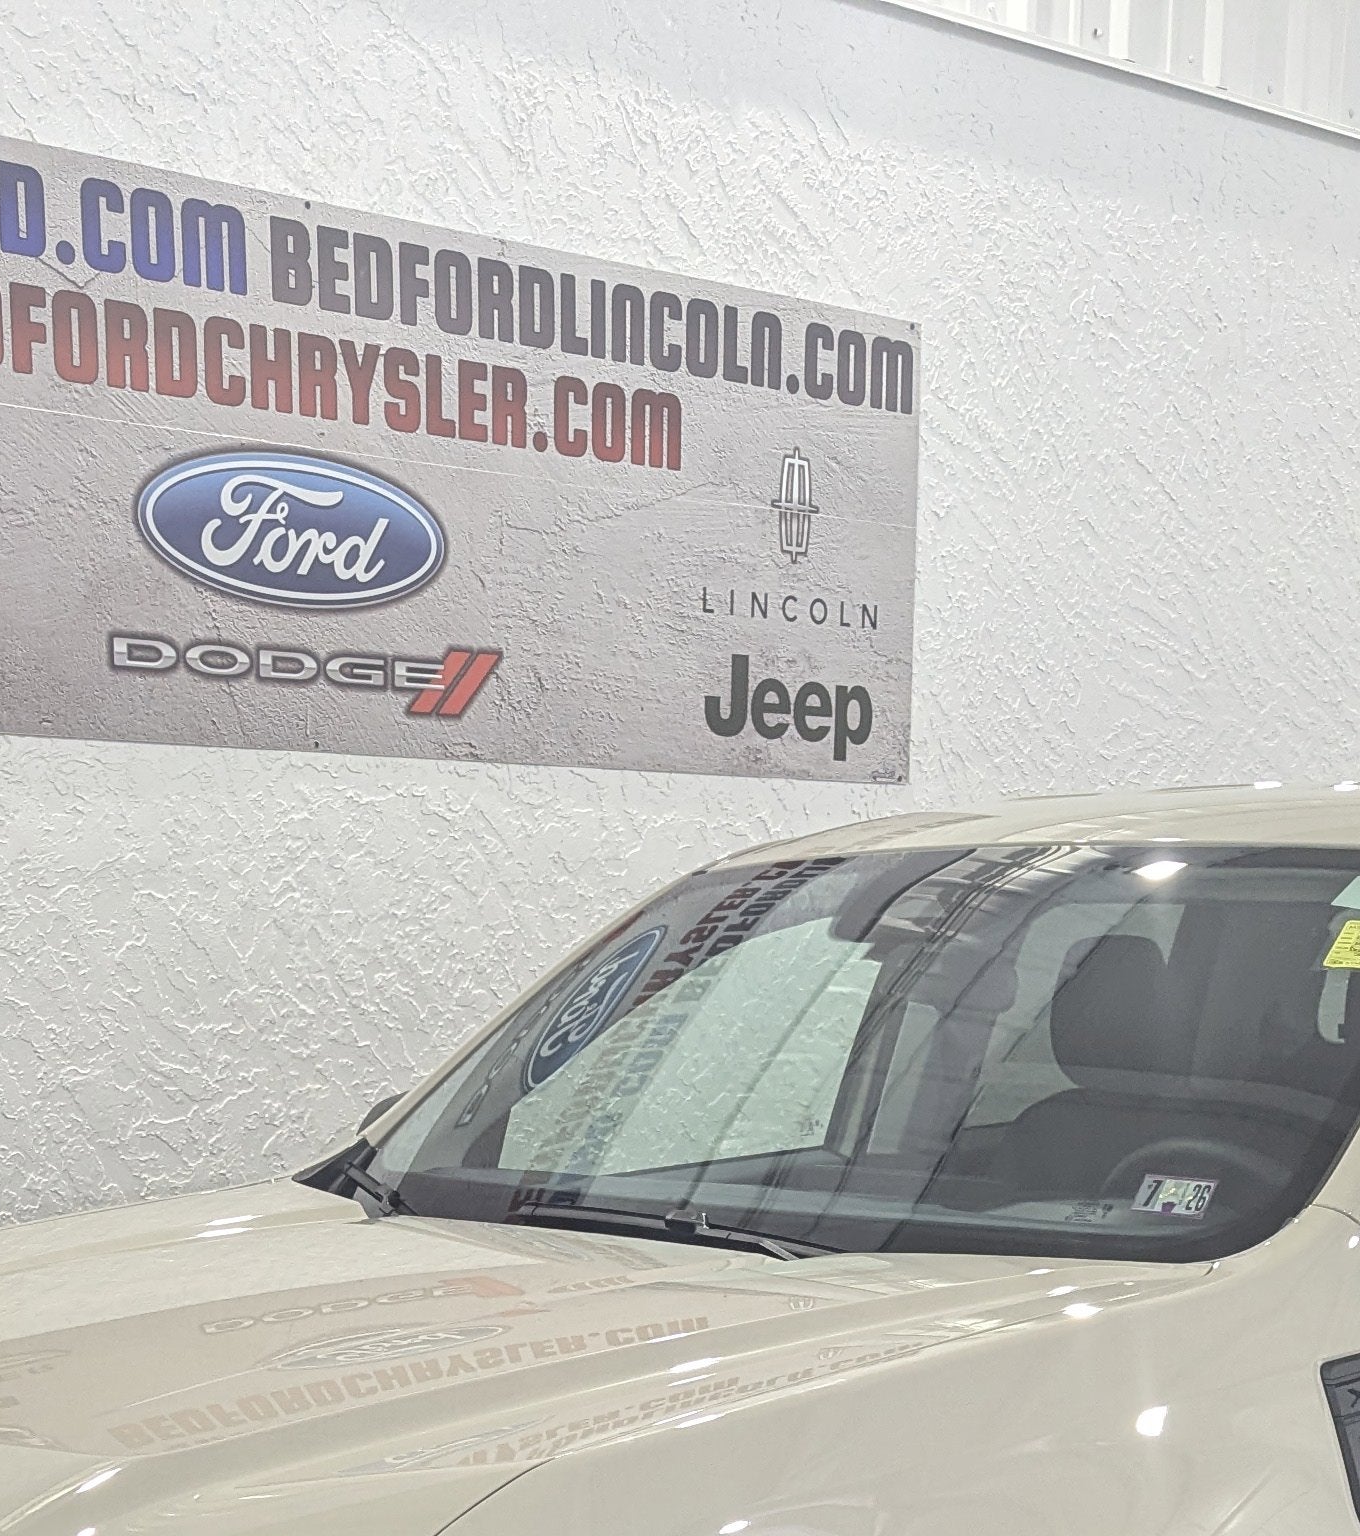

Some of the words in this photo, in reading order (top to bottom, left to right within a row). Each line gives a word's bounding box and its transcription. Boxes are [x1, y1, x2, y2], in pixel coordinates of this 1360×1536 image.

[270, 215, 913, 415] BEDFORDLINCOLN.COM
[200, 474, 388, 585] Ford
[701, 586, 879, 630] LINCOLN
[112, 636, 446, 692] DODGE
[703, 653, 873, 762] Jeep
[1185, 1184, 1212, 1212] 26
